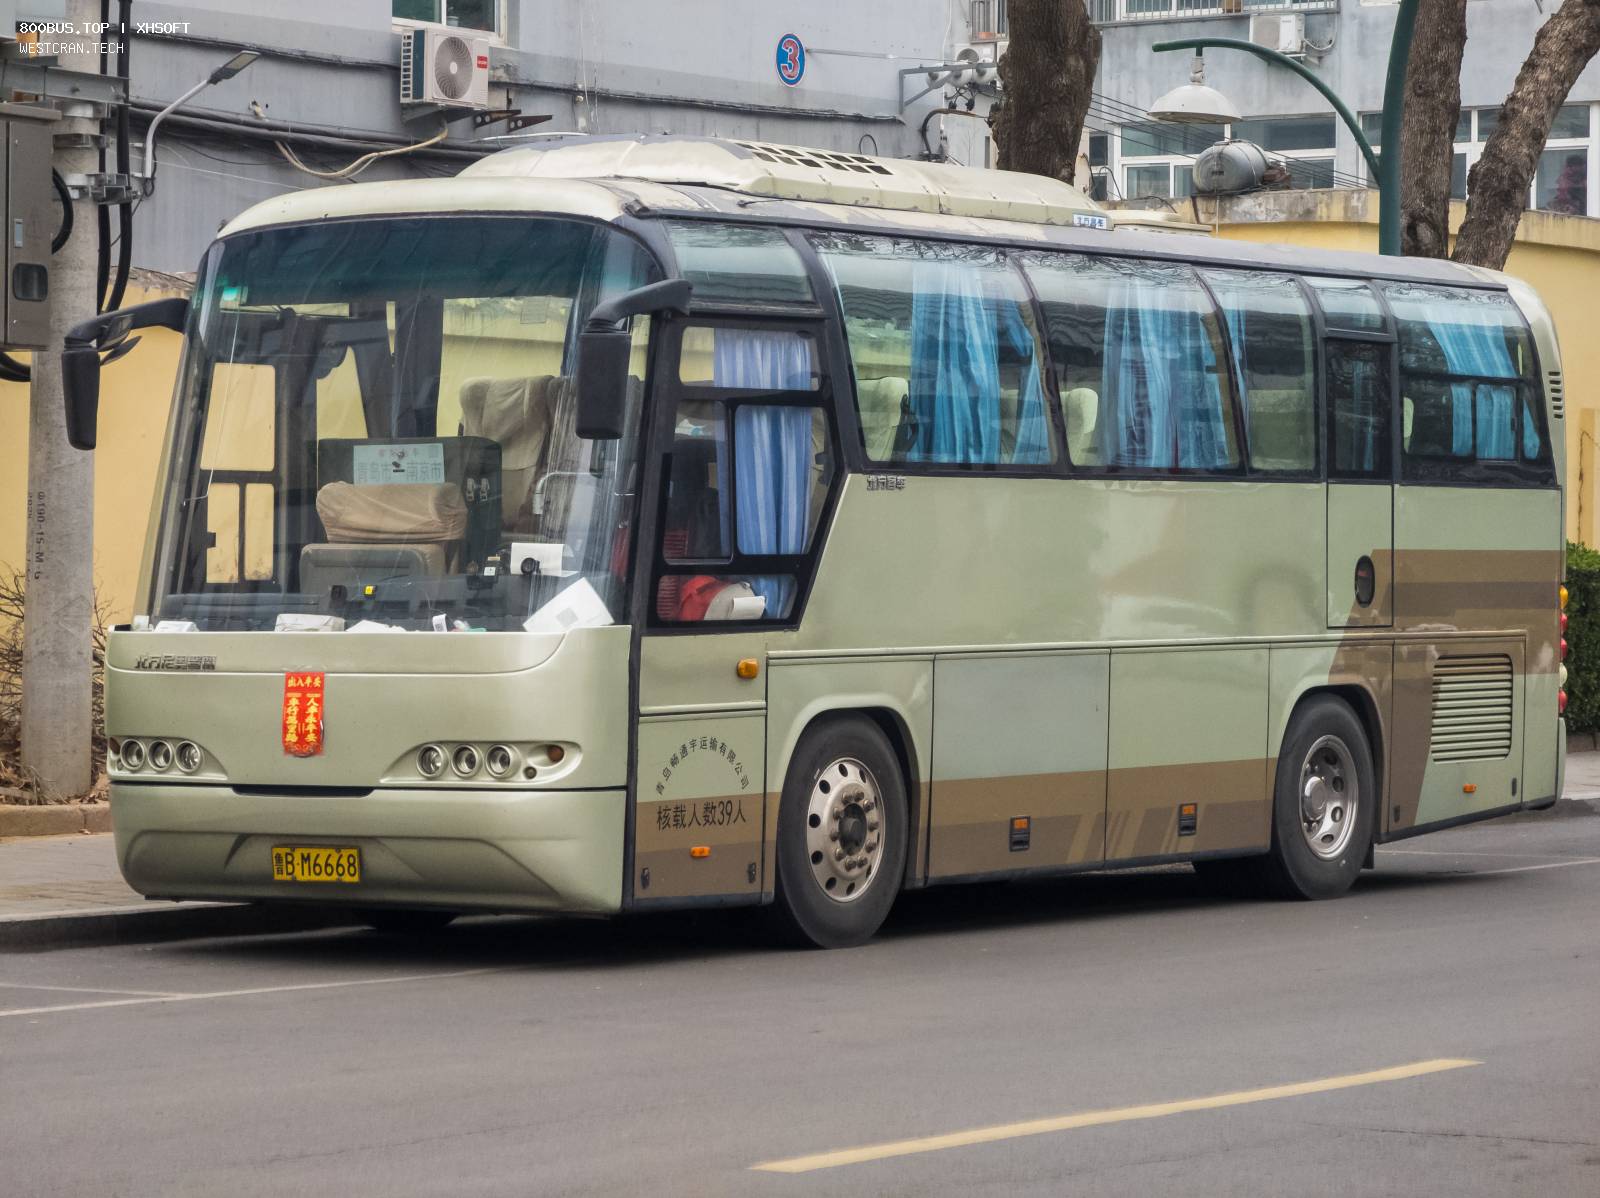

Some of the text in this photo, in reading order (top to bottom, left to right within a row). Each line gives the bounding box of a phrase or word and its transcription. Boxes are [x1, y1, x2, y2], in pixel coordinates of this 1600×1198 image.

[780, 38, 800, 80] 3
[287, 676, 321, 688] 出入平安
[656, 800, 747, 831] 核载人数39人
